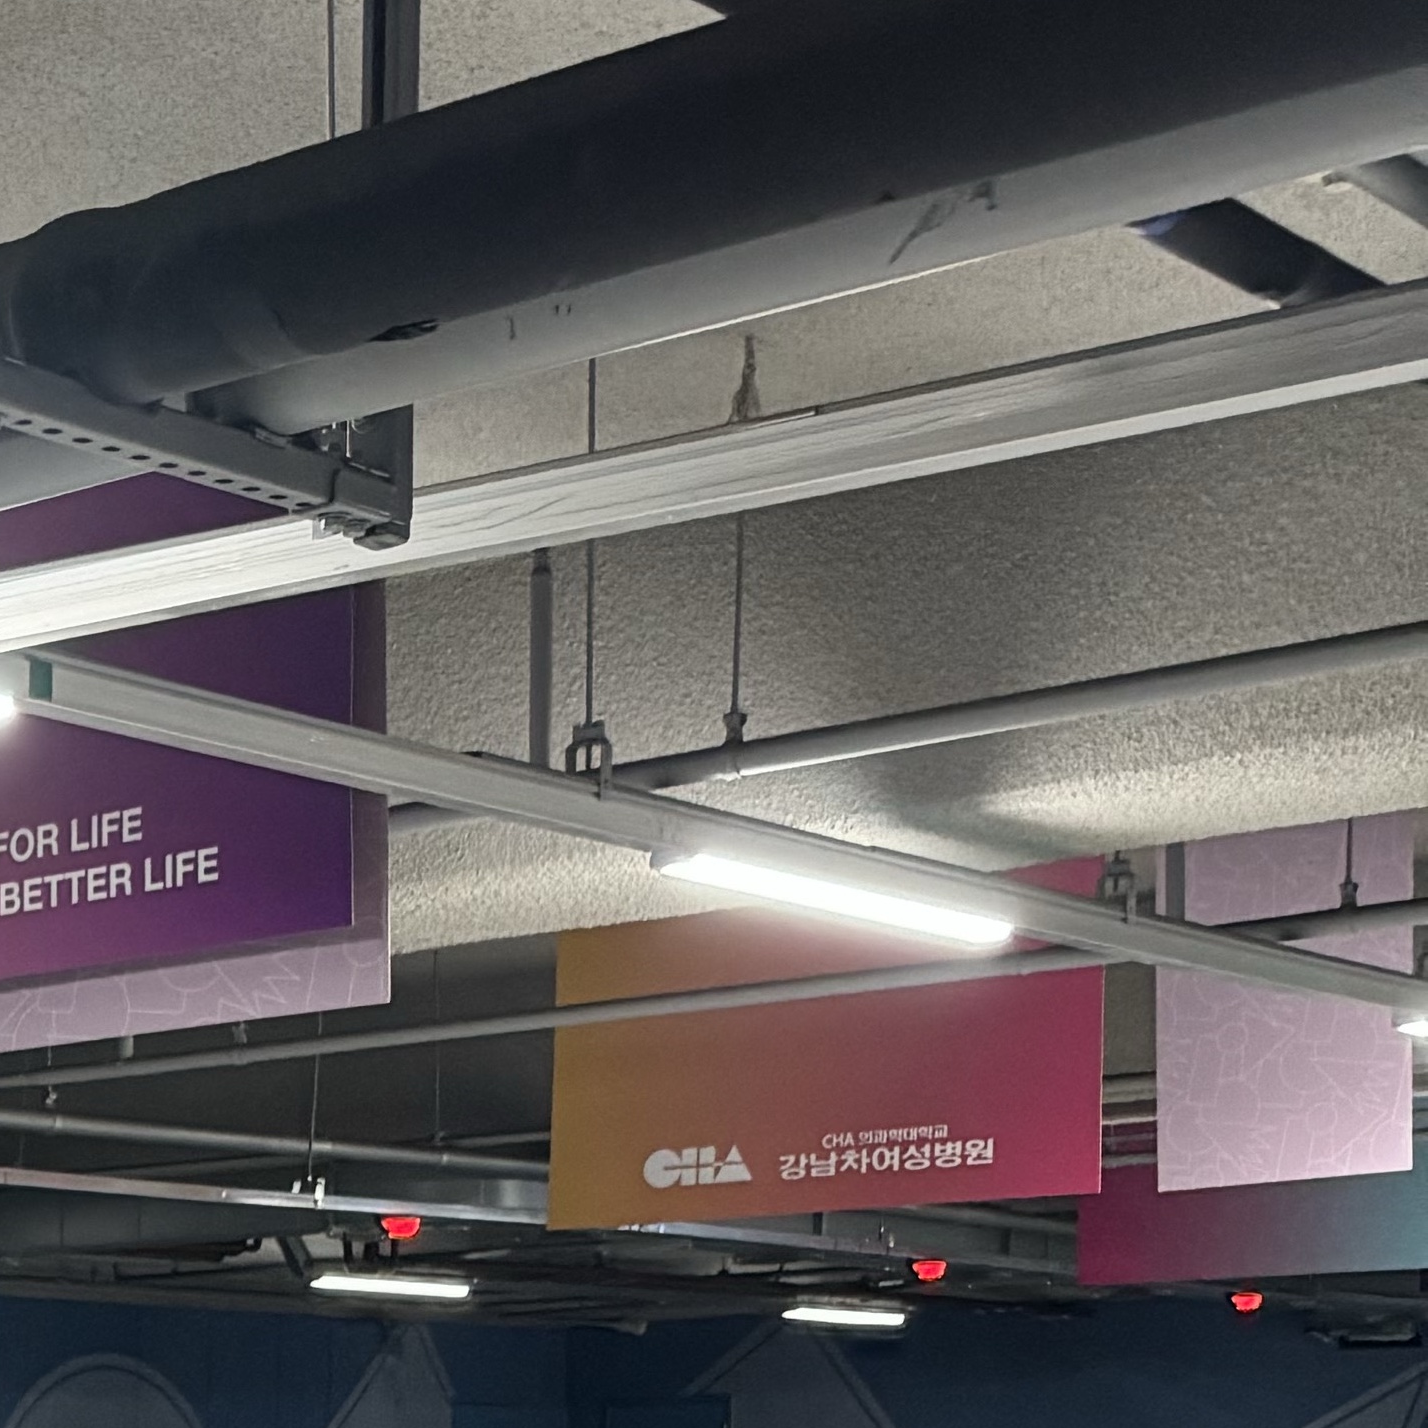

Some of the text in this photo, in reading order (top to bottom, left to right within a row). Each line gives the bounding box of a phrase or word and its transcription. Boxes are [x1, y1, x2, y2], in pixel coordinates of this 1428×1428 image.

[70, 806, 143, 852] LIFE
[0, 861, 132, 916] BETTER
[144, 846, 219, 892] LIFE
[779, 1138, 994, 1180] 강남차여성병원
[821, 1132, 855, 1149] CHA
[643, 1144, 752, 1188] CHA
